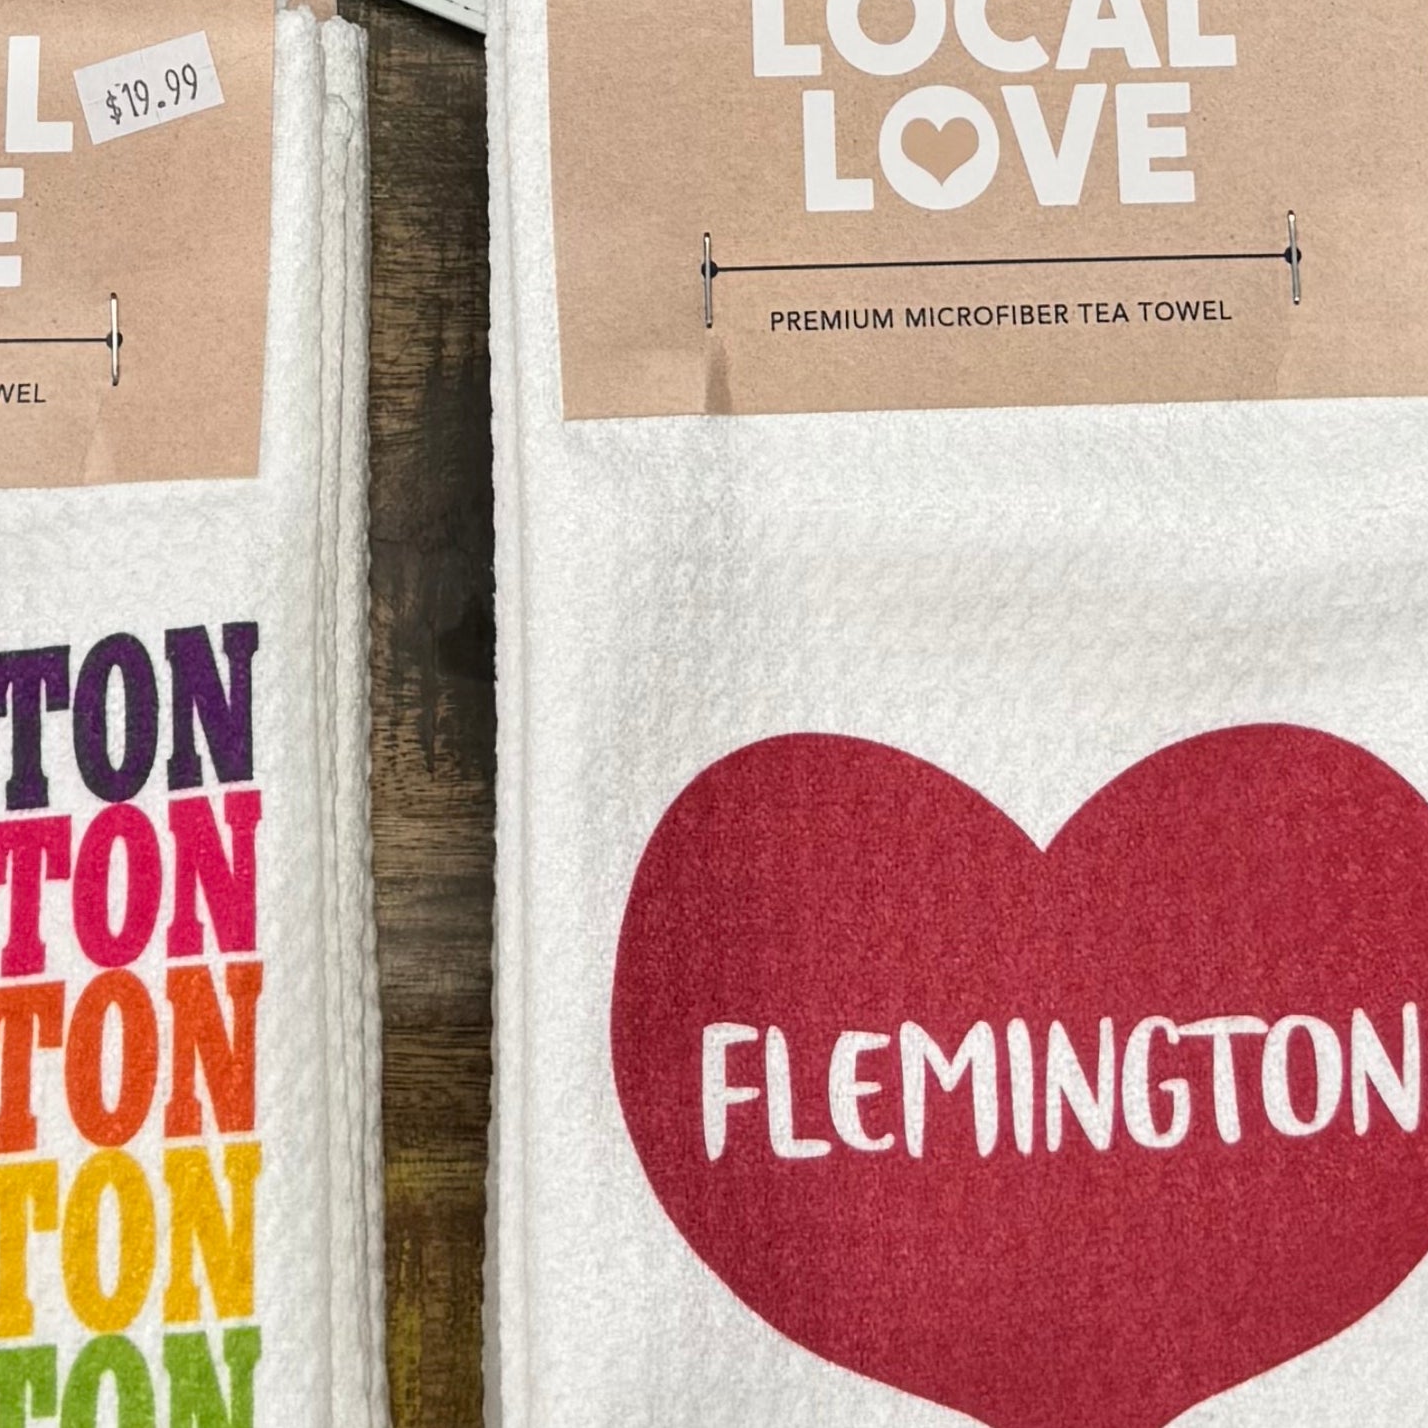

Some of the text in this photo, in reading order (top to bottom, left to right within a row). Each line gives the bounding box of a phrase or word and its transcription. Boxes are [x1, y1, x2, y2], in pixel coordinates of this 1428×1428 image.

[104, 61, 199, 126] $19.99
[801, 81, 1197, 213] LOVE
[769, 298, 1233, 334] PREMIUM MICROFIBER TEA TOWEL
[700, 1001, 1424, 1163] FLEMINGTON
